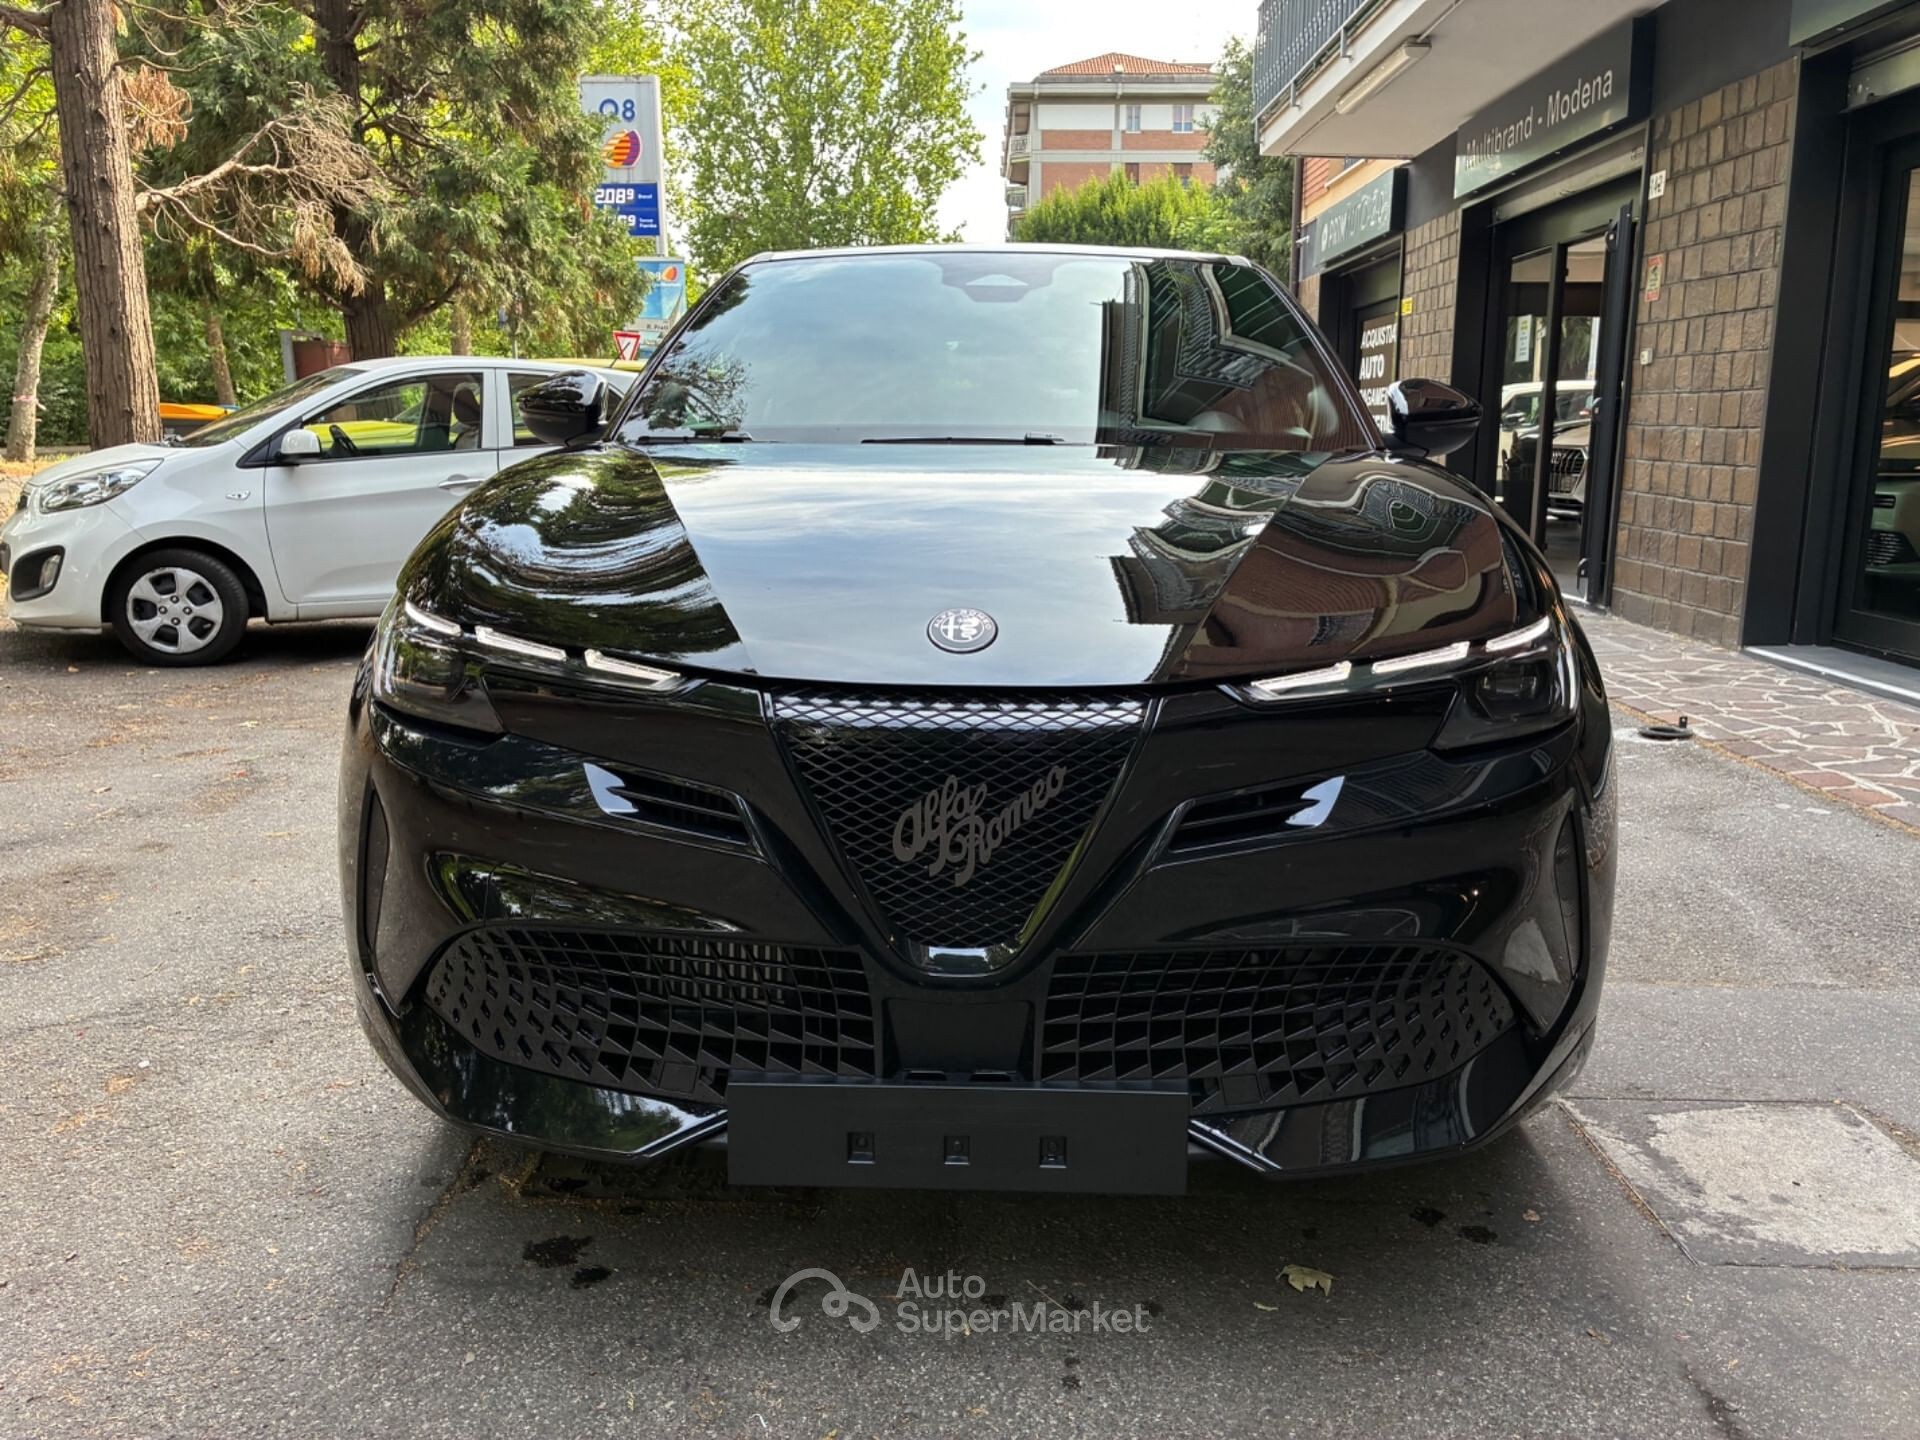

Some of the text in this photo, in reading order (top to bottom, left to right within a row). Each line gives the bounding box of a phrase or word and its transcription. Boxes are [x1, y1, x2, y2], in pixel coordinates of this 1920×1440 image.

[1465, 106, 1534, 171] Multibrand
[1547, 69, 1613, 128] Modena
[1359, 353, 1385, 381] AUTO
[892, 765, 1068, 888] Alfa Romeo
